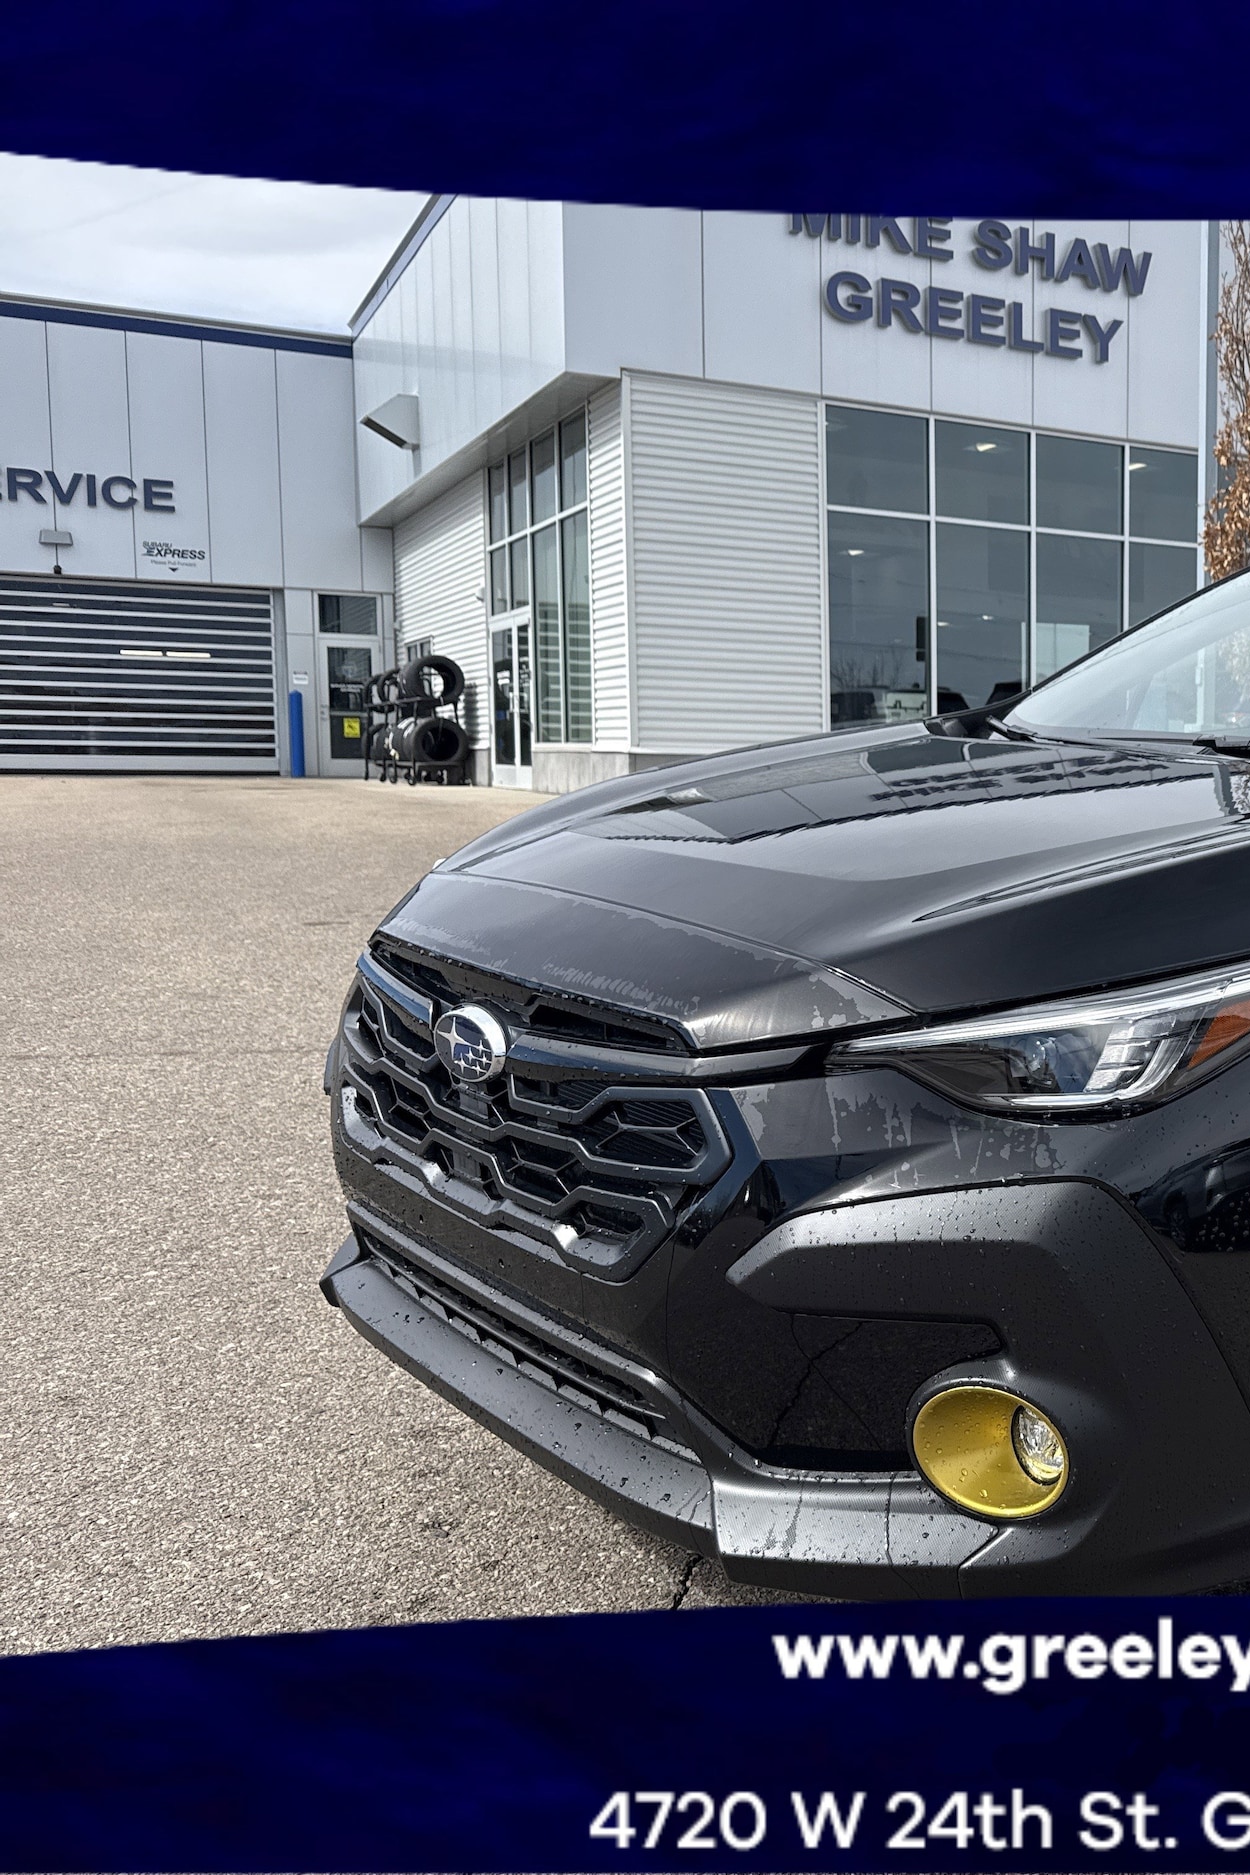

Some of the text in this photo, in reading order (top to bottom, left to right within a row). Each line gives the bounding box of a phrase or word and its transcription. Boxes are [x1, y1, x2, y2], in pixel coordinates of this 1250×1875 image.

[971, 219, 1152, 296] SHAW
[826, 271, 1124, 364] GREELEY
[0, 467, 175, 513] RVICE
[142, 546, 206, 560] EXPRESS
